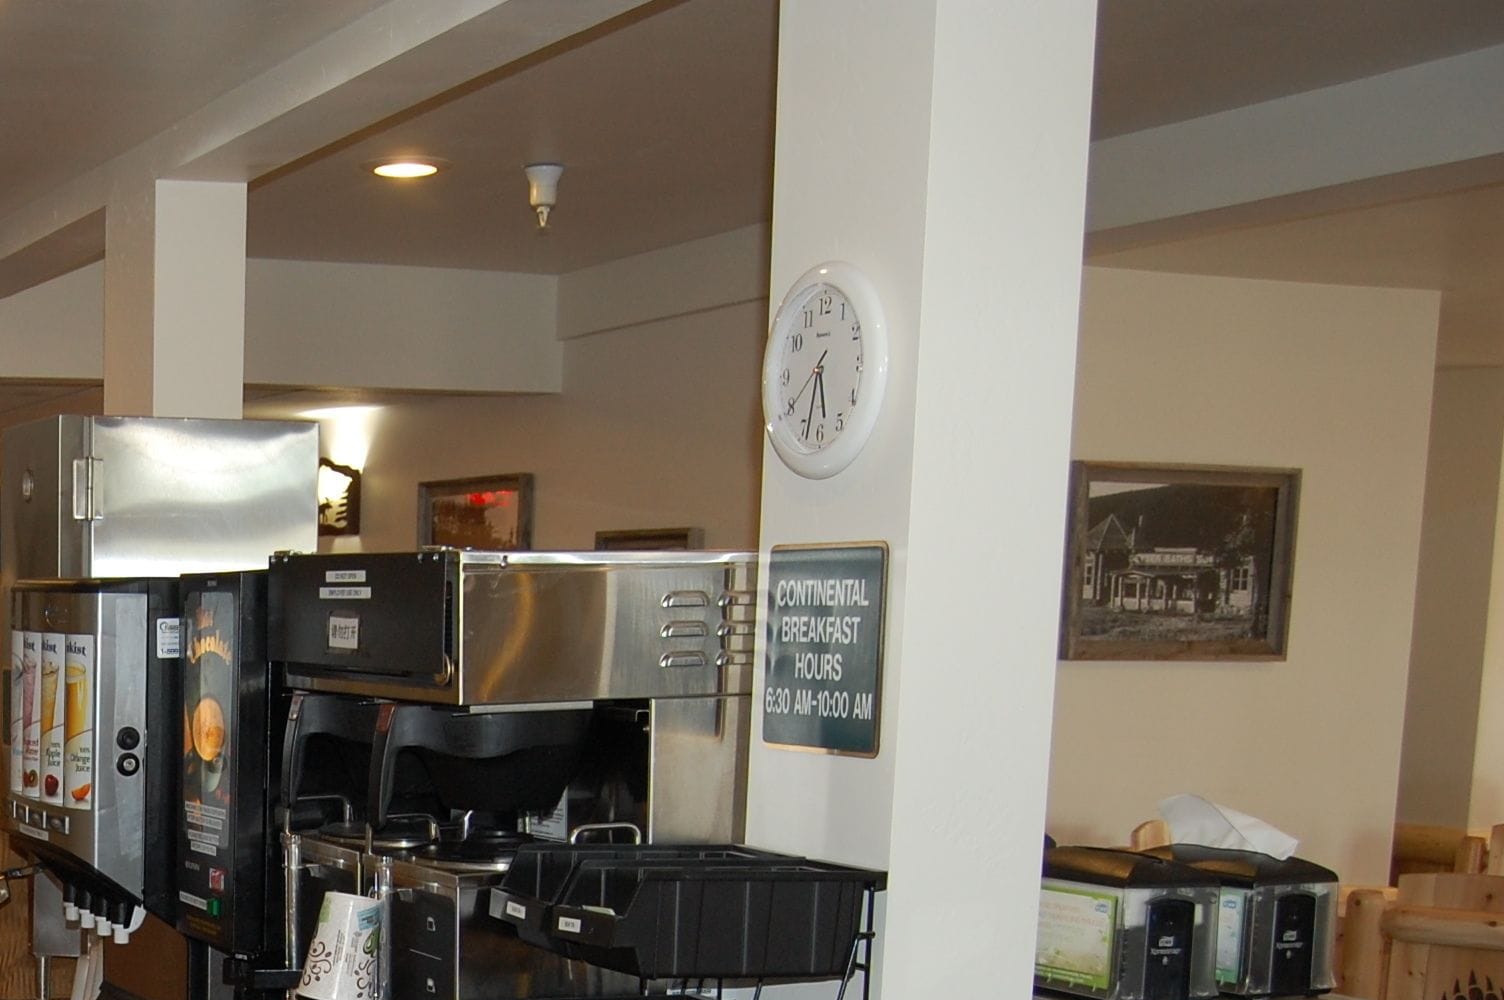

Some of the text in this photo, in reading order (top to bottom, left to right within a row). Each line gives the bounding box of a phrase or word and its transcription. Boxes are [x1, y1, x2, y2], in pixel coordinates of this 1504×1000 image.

[819, 296, 833, 316] 12
[840, 302, 846, 321] 1
[803, 310, 813, 329] 11
[791, 332, 803, 353] 10
[851, 325, 860, 341] 2
[782, 368, 790, 386] 9
[786, 397, 795, 417] 8
[800, 418, 808, 438] 7
[835, 412, 844, 432] 5
[815, 423, 824, 442] 6
[777, 578, 870, 607] CONTINENTAL
[782, 616, 861, 645] BREAKFAST
[795, 653, 843, 682] HOURS
[766, 687, 872, 721] 6:30 AM-10:00 AM
